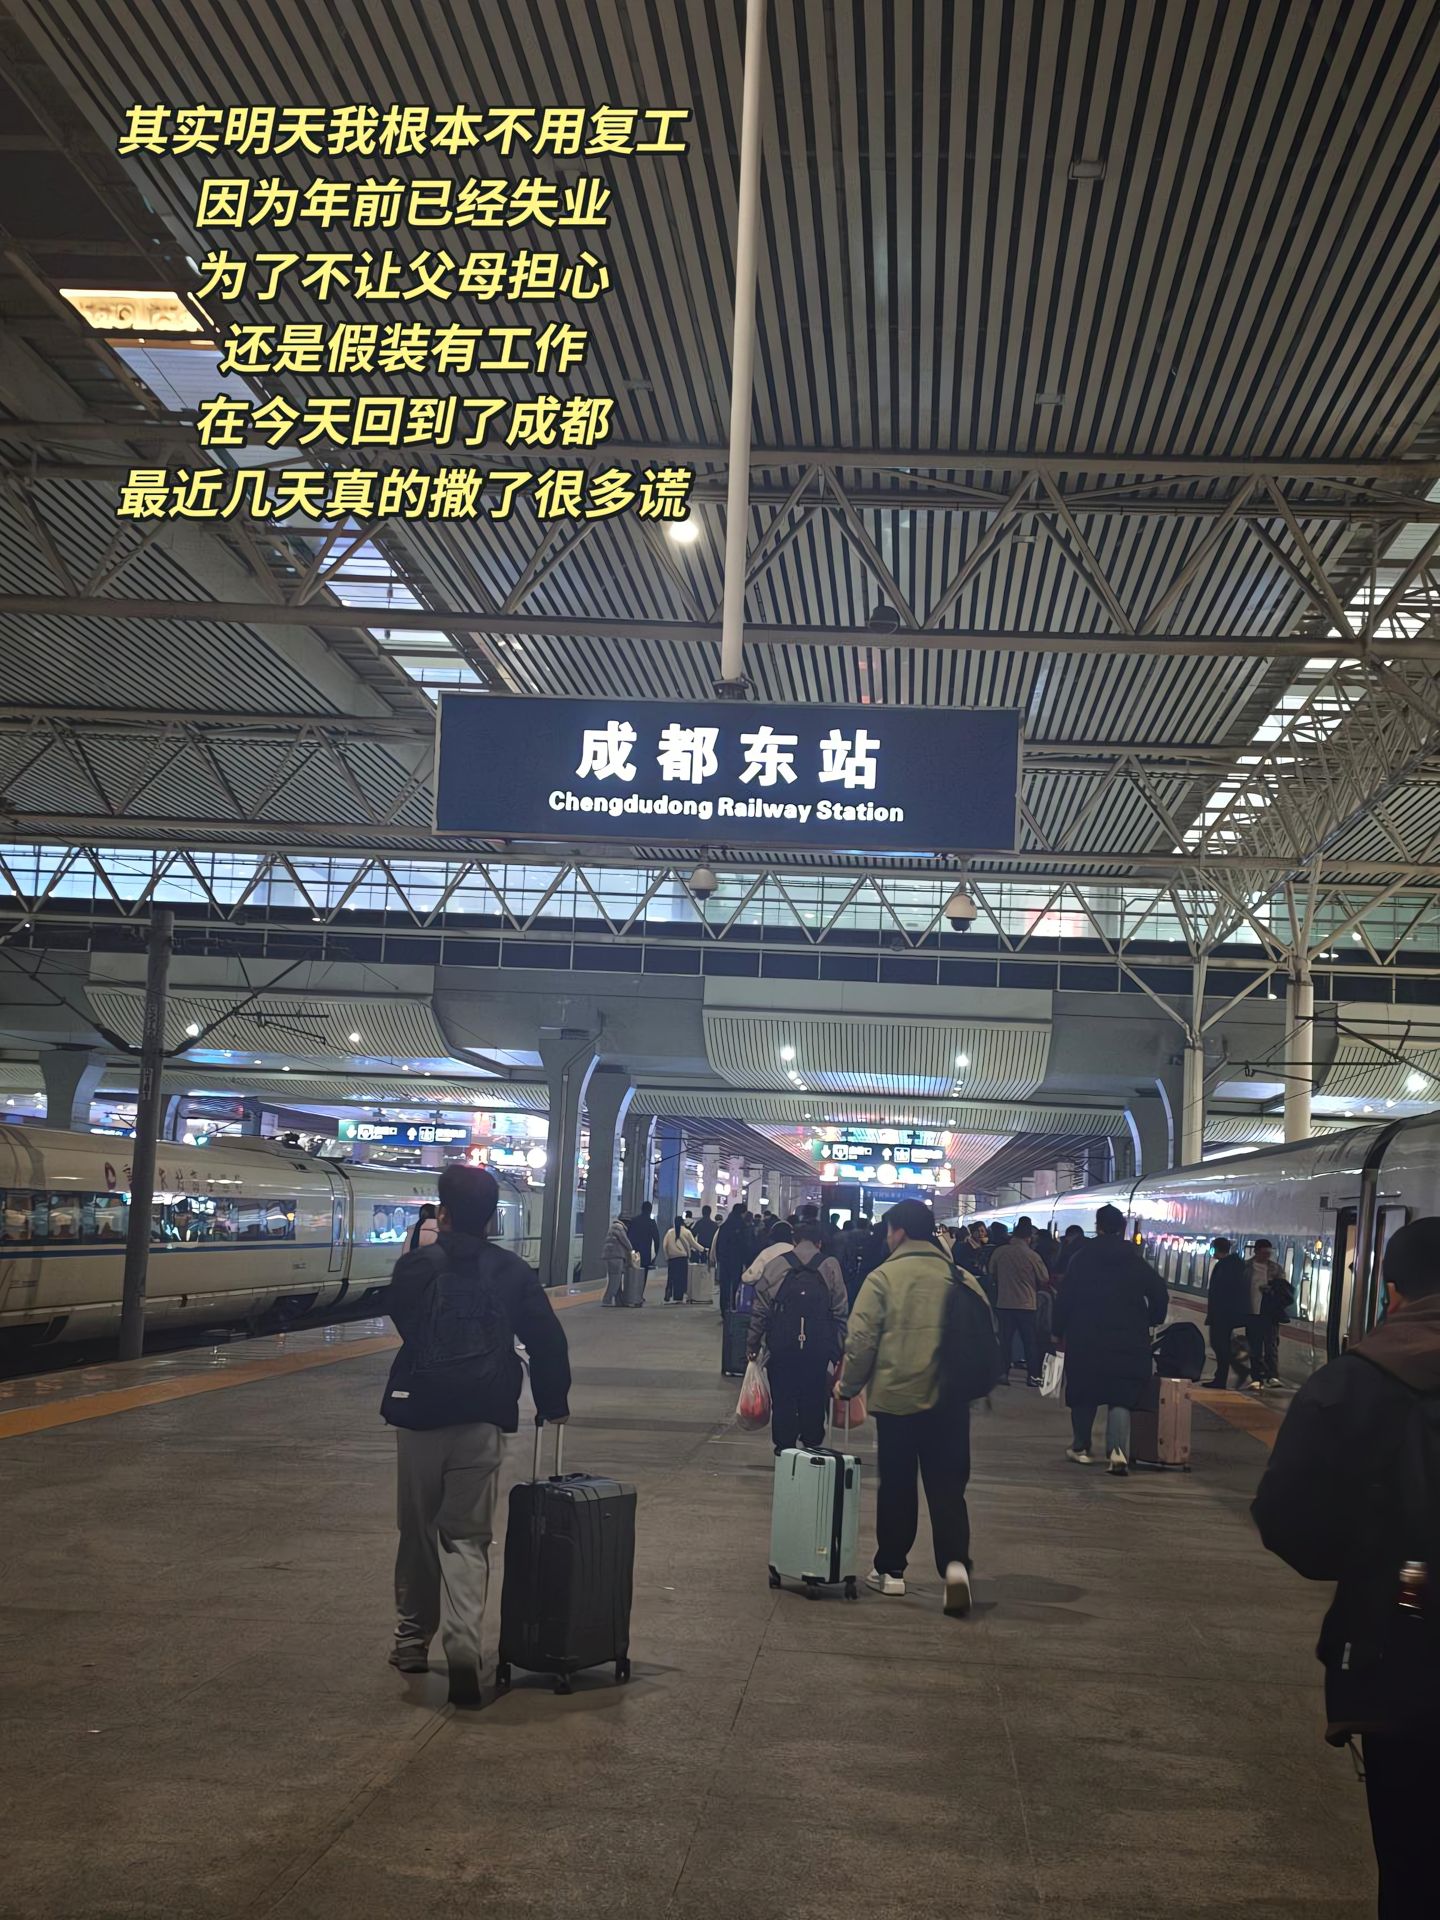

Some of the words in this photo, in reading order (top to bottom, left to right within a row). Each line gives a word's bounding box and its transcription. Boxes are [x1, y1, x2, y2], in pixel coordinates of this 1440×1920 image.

[575, 720, 881, 790] 成都东站
[548, 790, 713, 821] Chengdudong
[717, 797, 812, 824] Railway
[815, 800, 904, 823] Station
